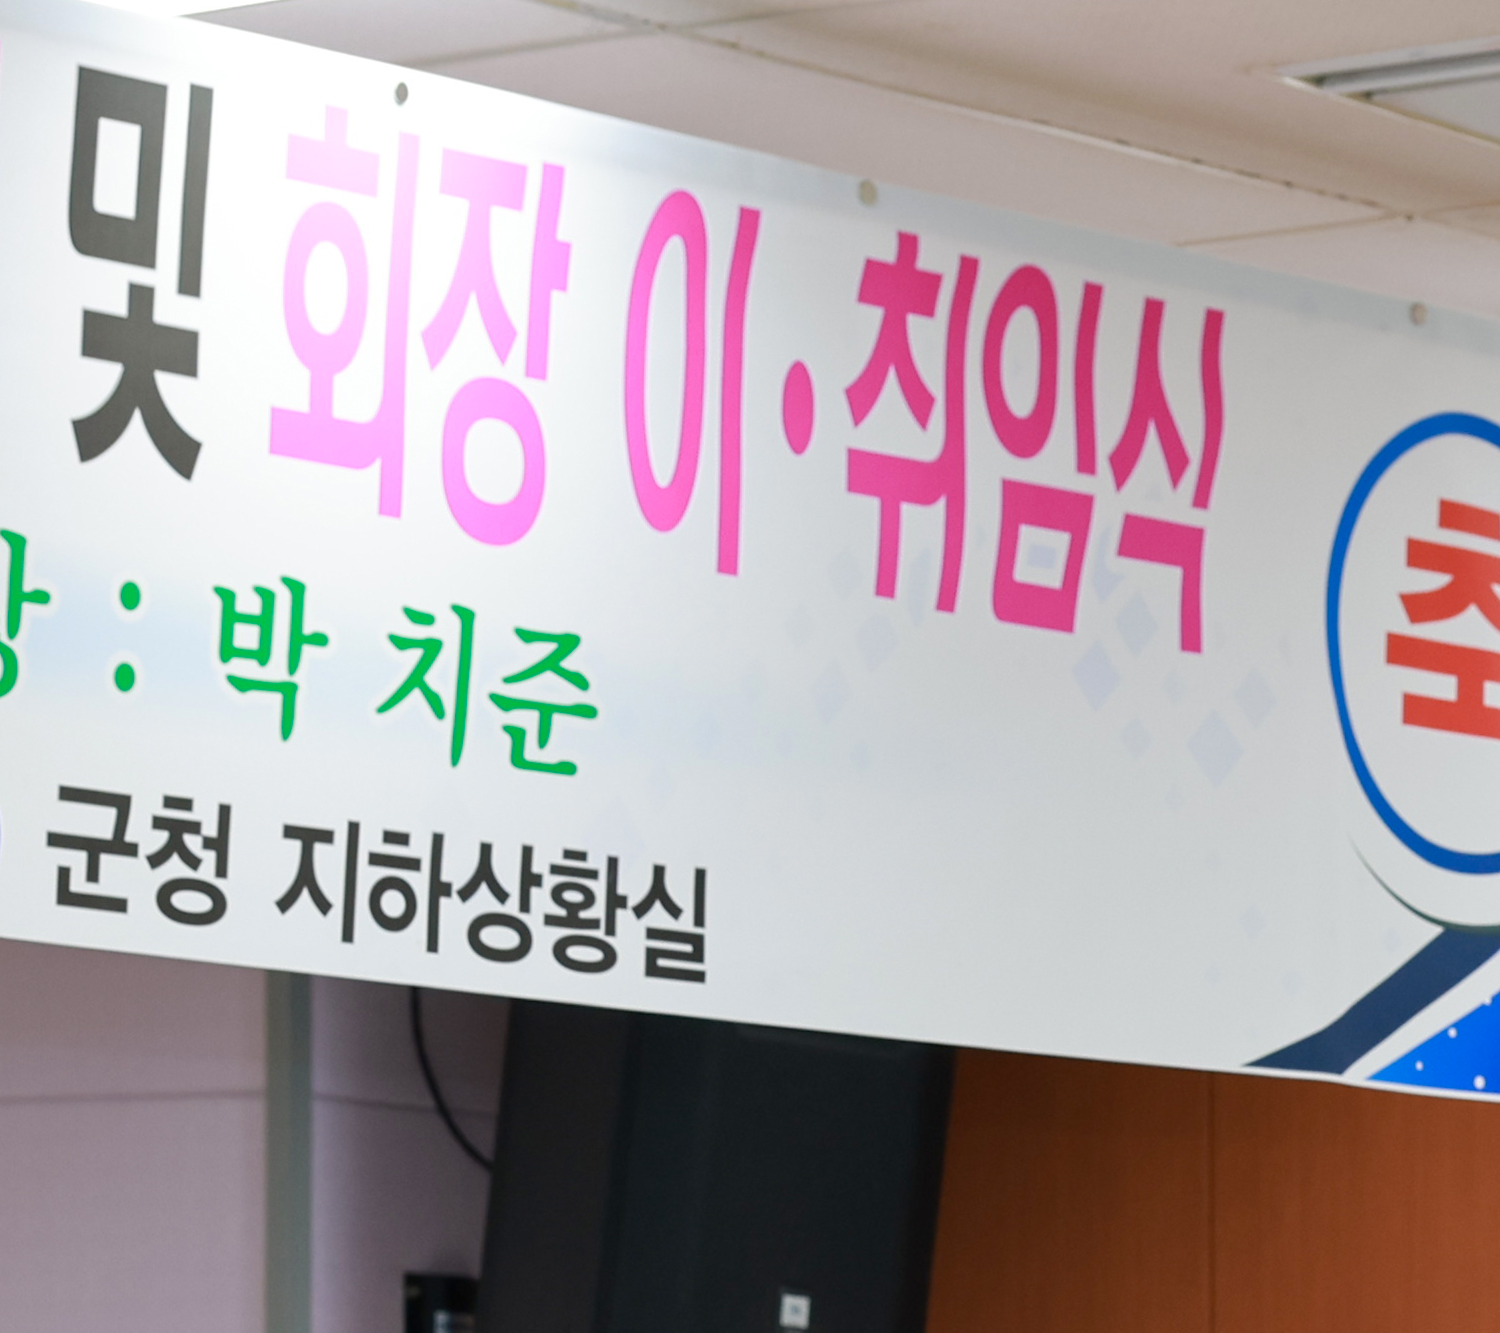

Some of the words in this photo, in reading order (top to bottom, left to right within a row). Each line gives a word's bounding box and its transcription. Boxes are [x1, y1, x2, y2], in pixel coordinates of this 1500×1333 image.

[68, 65, 214, 481] 및
[269, 105, 572, 546] 회장
[624, 187, 1226, 654] 이·취임식
[213, 575, 329, 742] 박
[376, 603, 599, 776] 치준
[46, 784, 232, 926] 군청
[275, 819, 708, 984] 지하상황실
